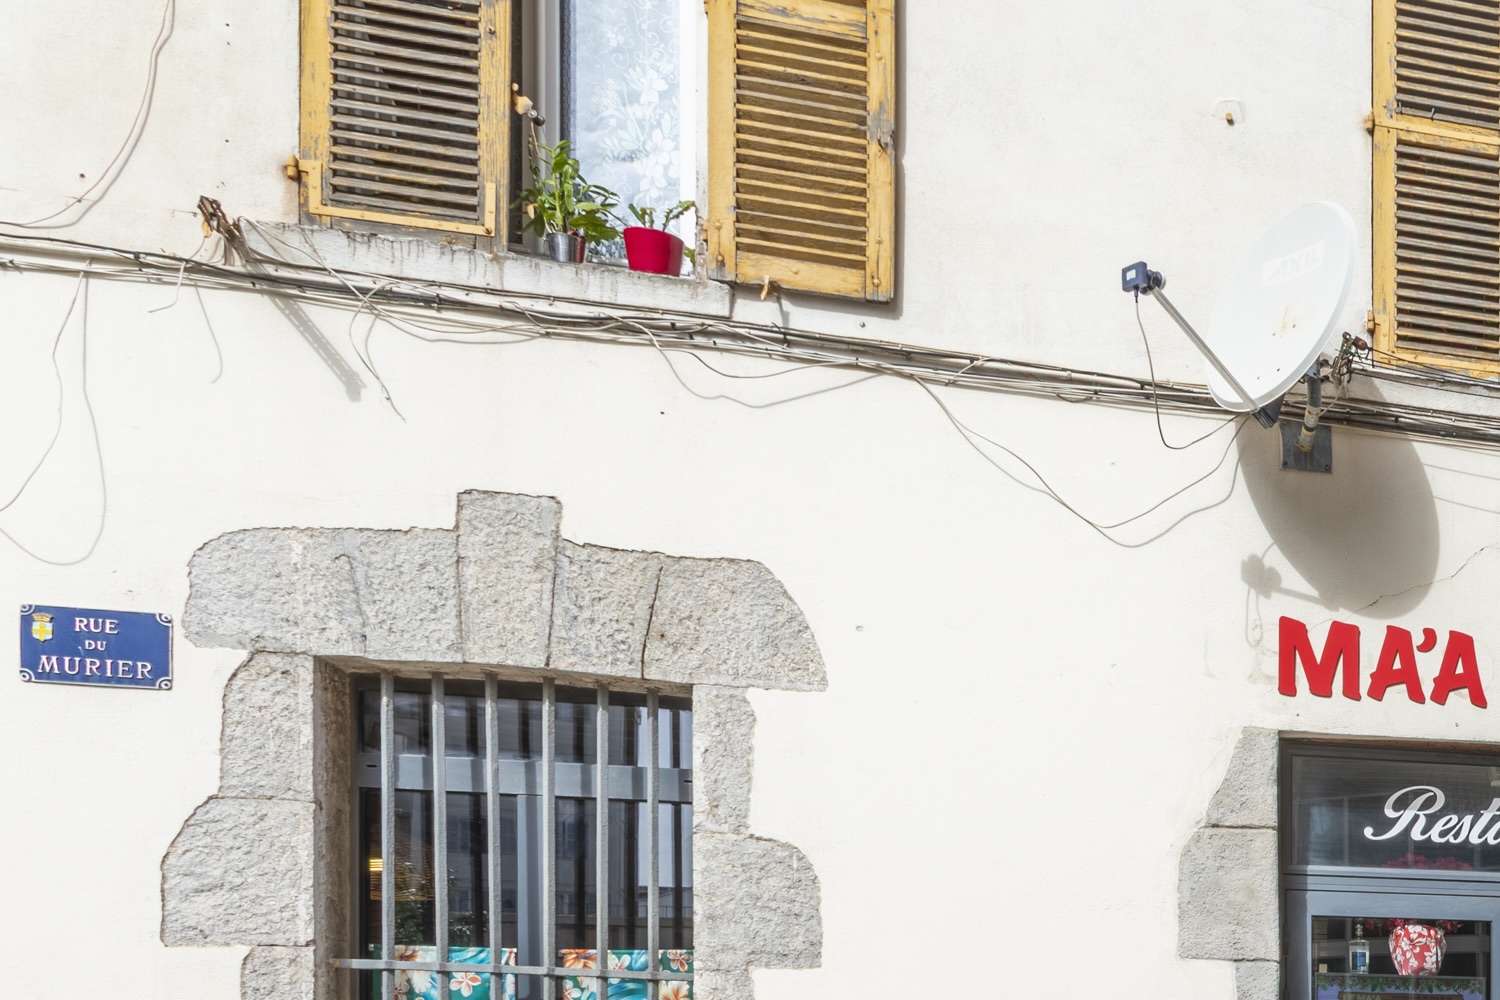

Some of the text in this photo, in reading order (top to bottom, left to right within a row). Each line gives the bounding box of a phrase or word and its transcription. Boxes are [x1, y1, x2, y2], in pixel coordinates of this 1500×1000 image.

[75, 617, 120, 634] RUE
[84, 640, 108, 651] DU
[38, 655, 153, 679] MURIER
[1278, 615, 1488, 709] MA'A
